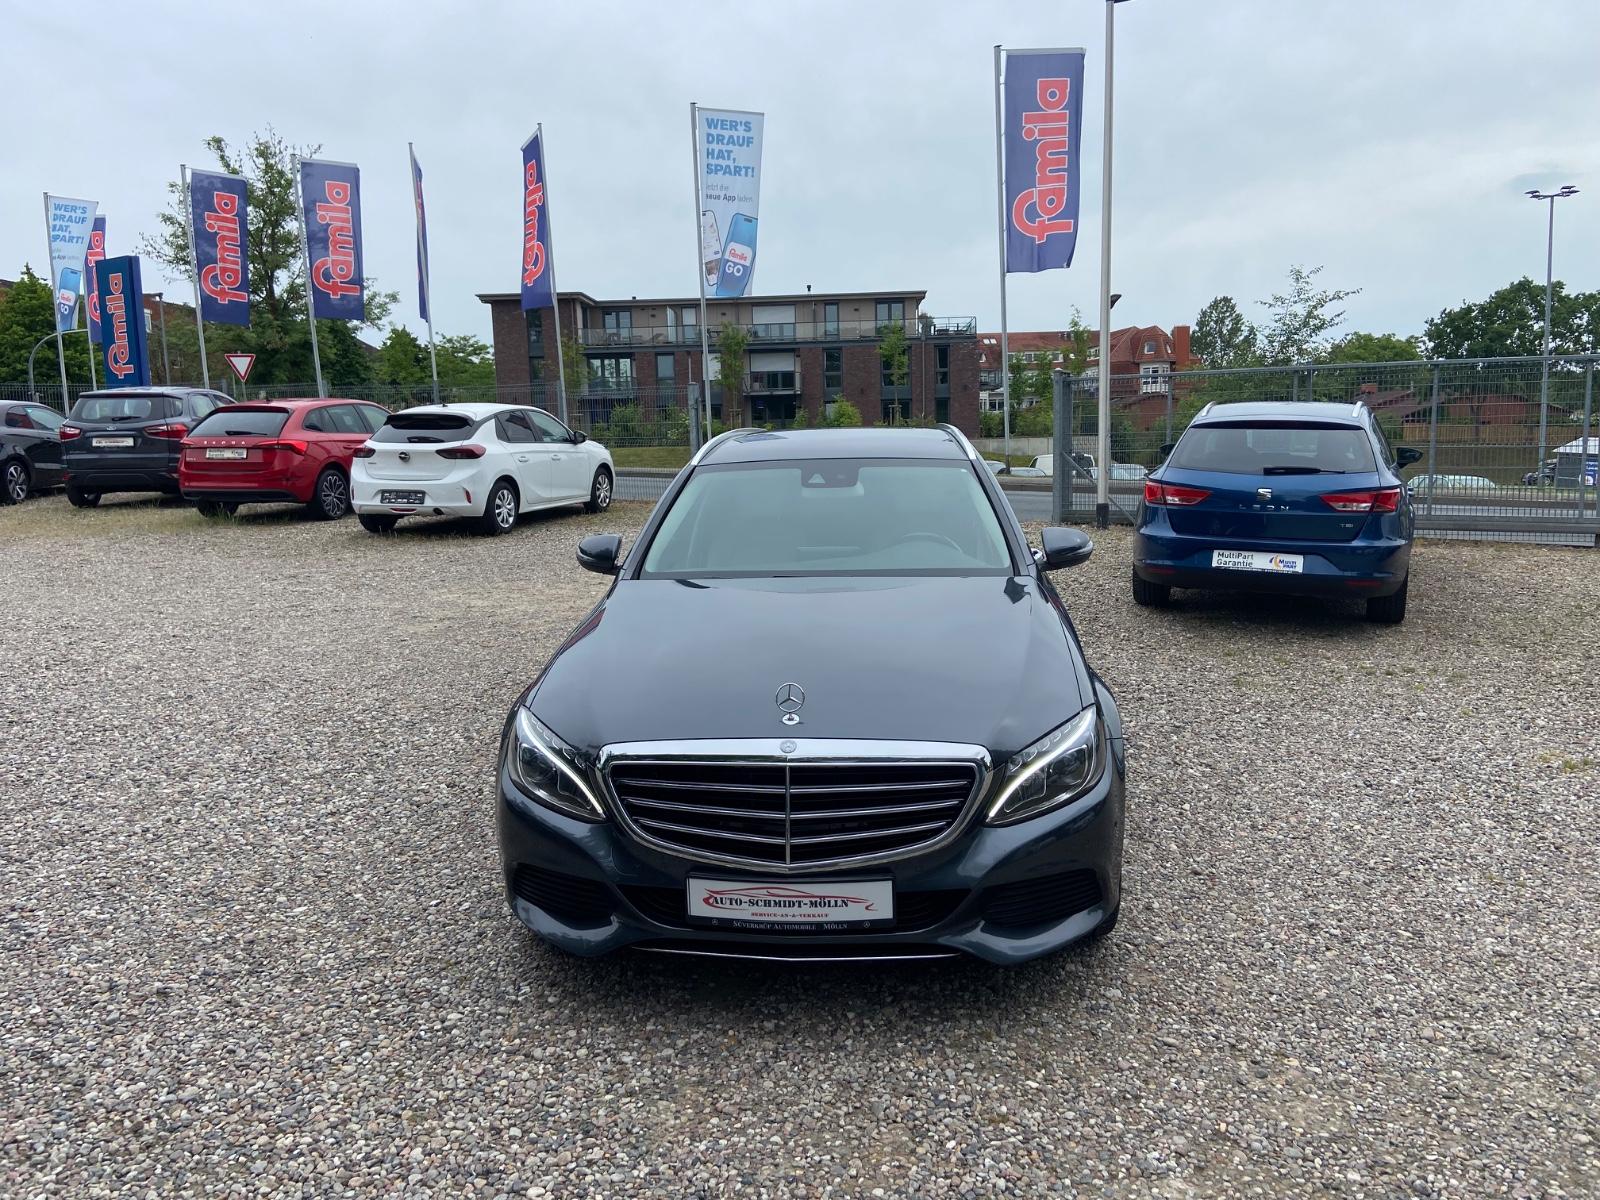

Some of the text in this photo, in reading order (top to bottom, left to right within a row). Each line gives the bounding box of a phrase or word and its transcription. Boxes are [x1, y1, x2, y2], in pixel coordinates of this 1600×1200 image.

[705, 117, 752, 132] WER'S
[706, 132, 754, 148] DRAUF
[706, 147, 737, 164] HAT,
[1012, 78, 1073, 244] famila
[706, 163, 755, 178] SPART!
[722, 193, 736, 203] App
[53, 202, 88, 215] WER'S
[52, 213, 88, 225] DRAUF
[312, 180, 361, 299] famila
[201, 191, 248, 304] famila
[725, 262, 743, 277] GO
[105, 272, 135, 379] famila
[1216, 558, 1253, 568] Garantie
[1217, 551, 1254, 560] MultiPart
[712, 896, 849, 909] AUTO-SCHMIDT-MÖLLN
